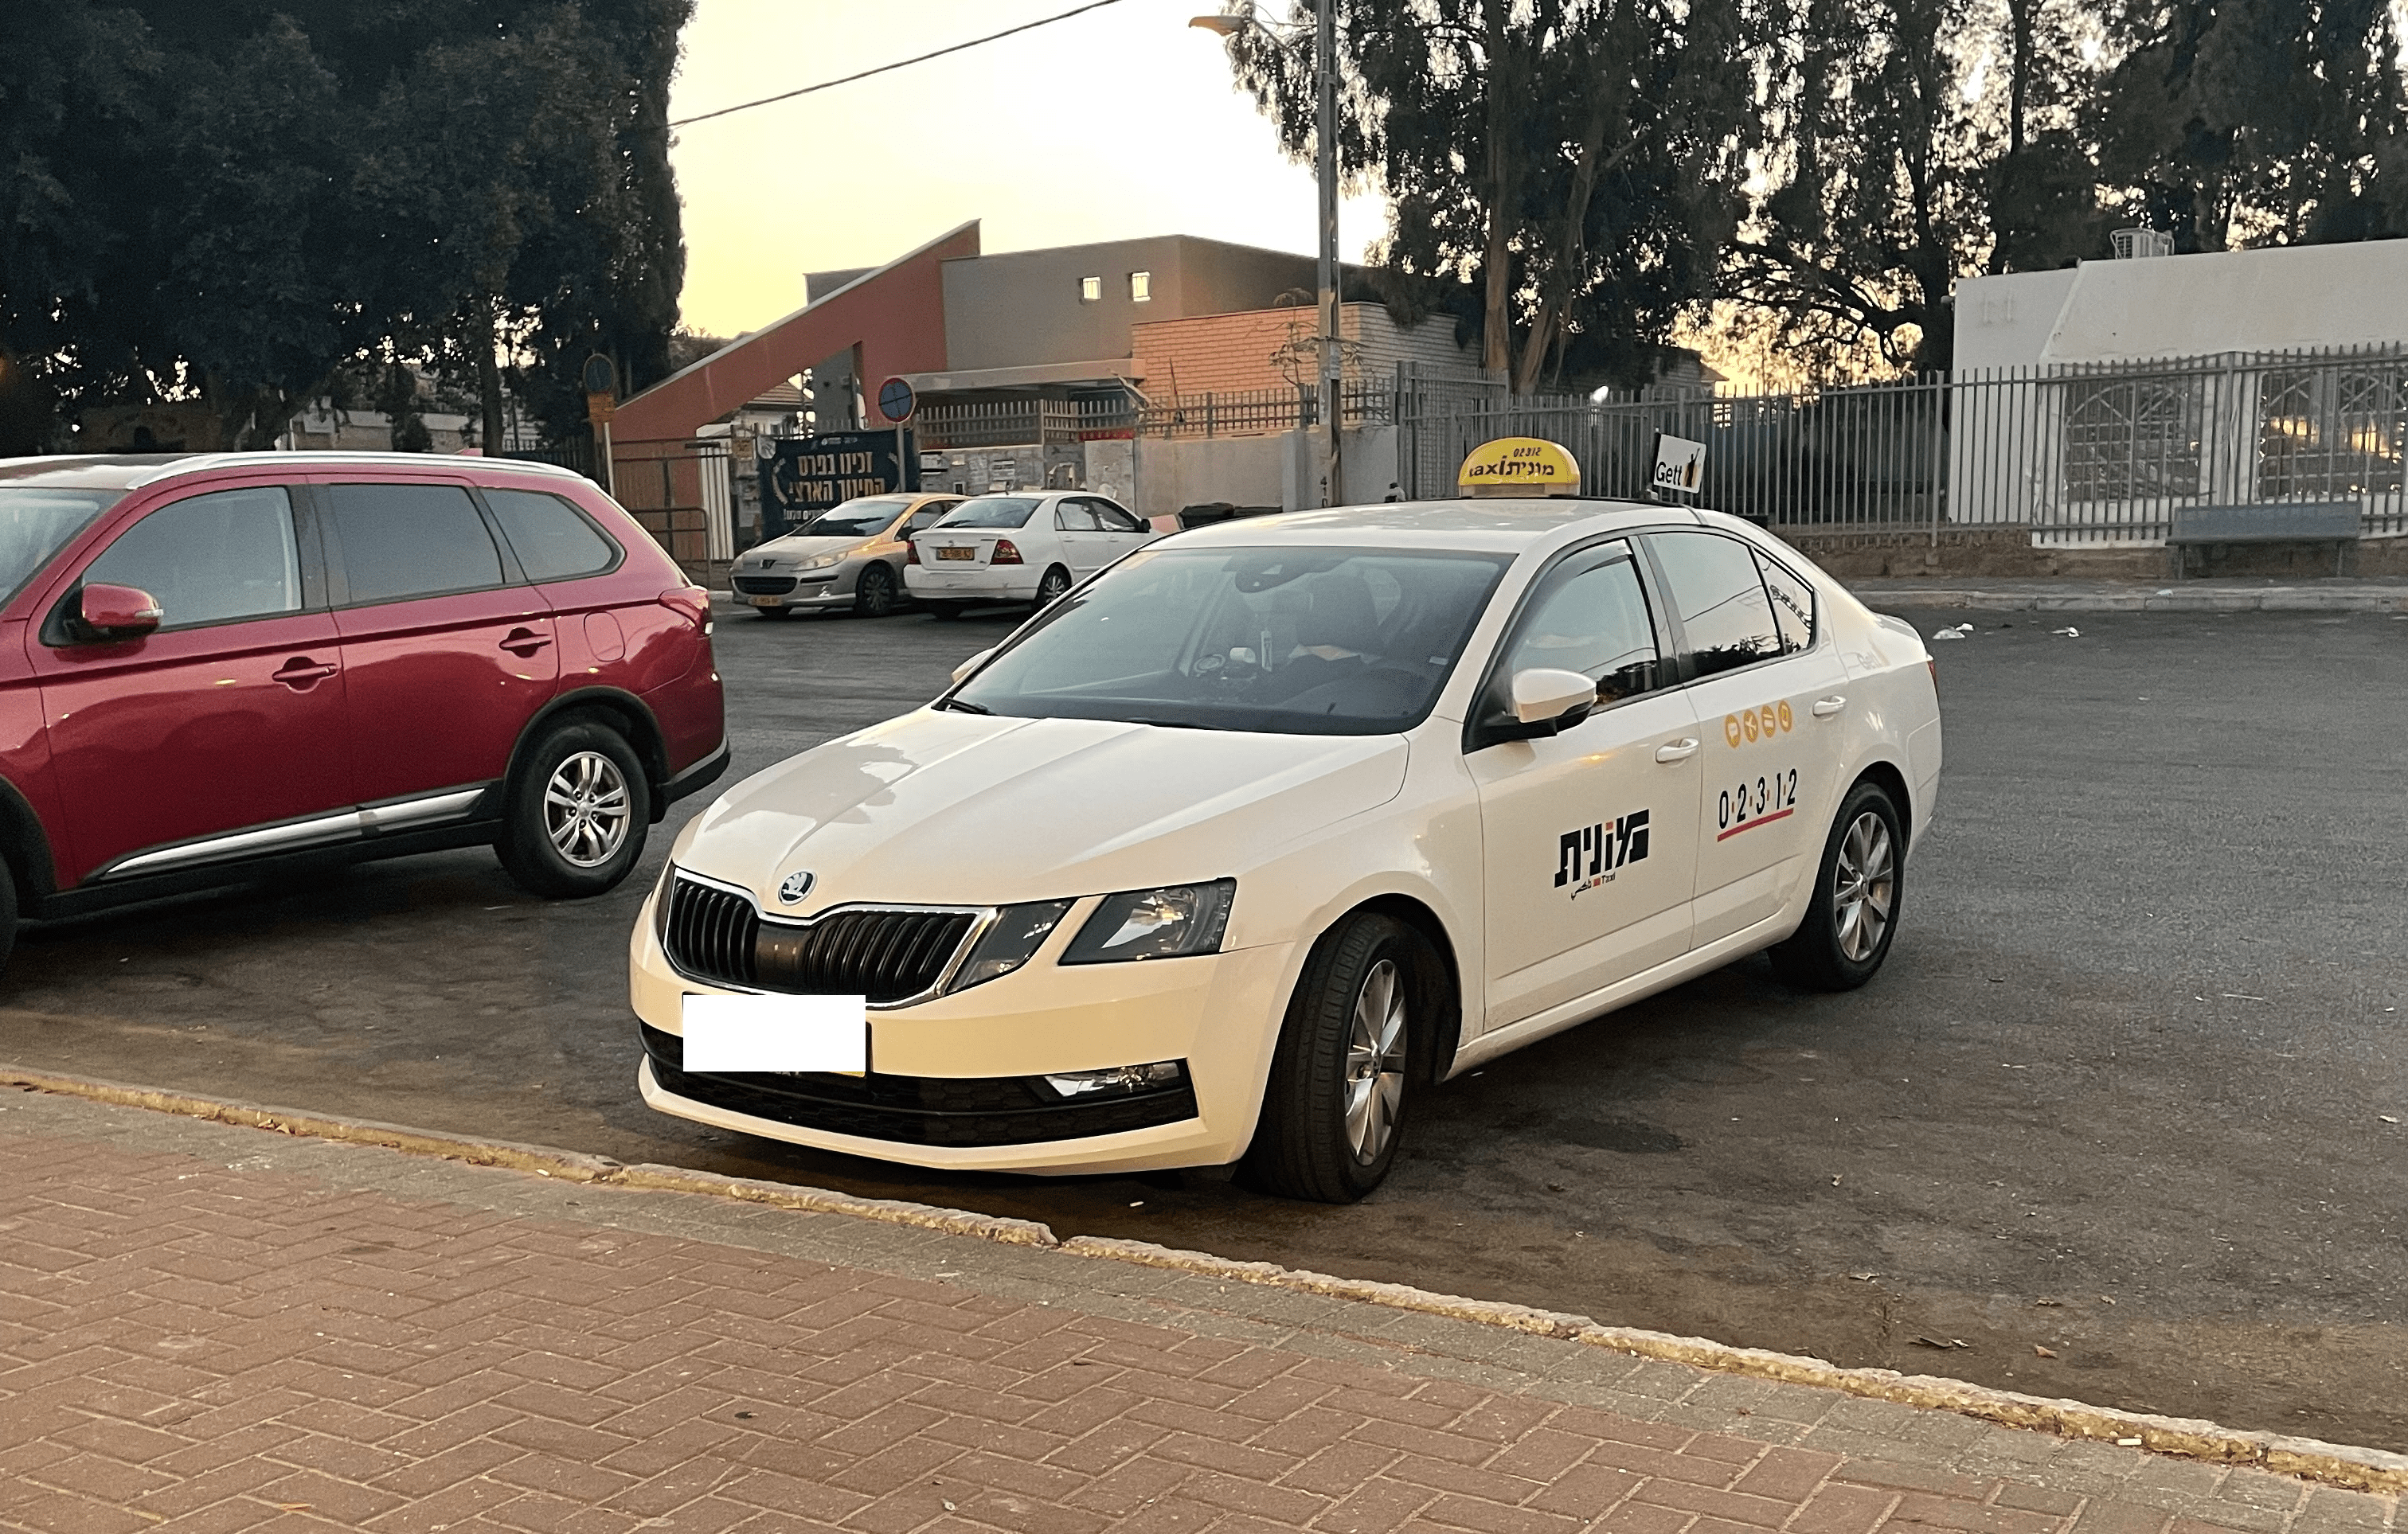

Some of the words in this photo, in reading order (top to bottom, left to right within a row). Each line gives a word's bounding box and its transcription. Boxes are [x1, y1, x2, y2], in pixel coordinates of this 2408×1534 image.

[798, 454, 836, 476] בפרס
[839, 451, 873, 474] זכינו
[1469, 455, 1507, 478] taxi
[1506, 462, 1554, 476] מונית
[1656, 462, 1682, 486] Gett
[788, 480, 834, 502] הארצי
[837, 478, 885, 502] החינוך
[1554, 809, 1649, 888] מונית
